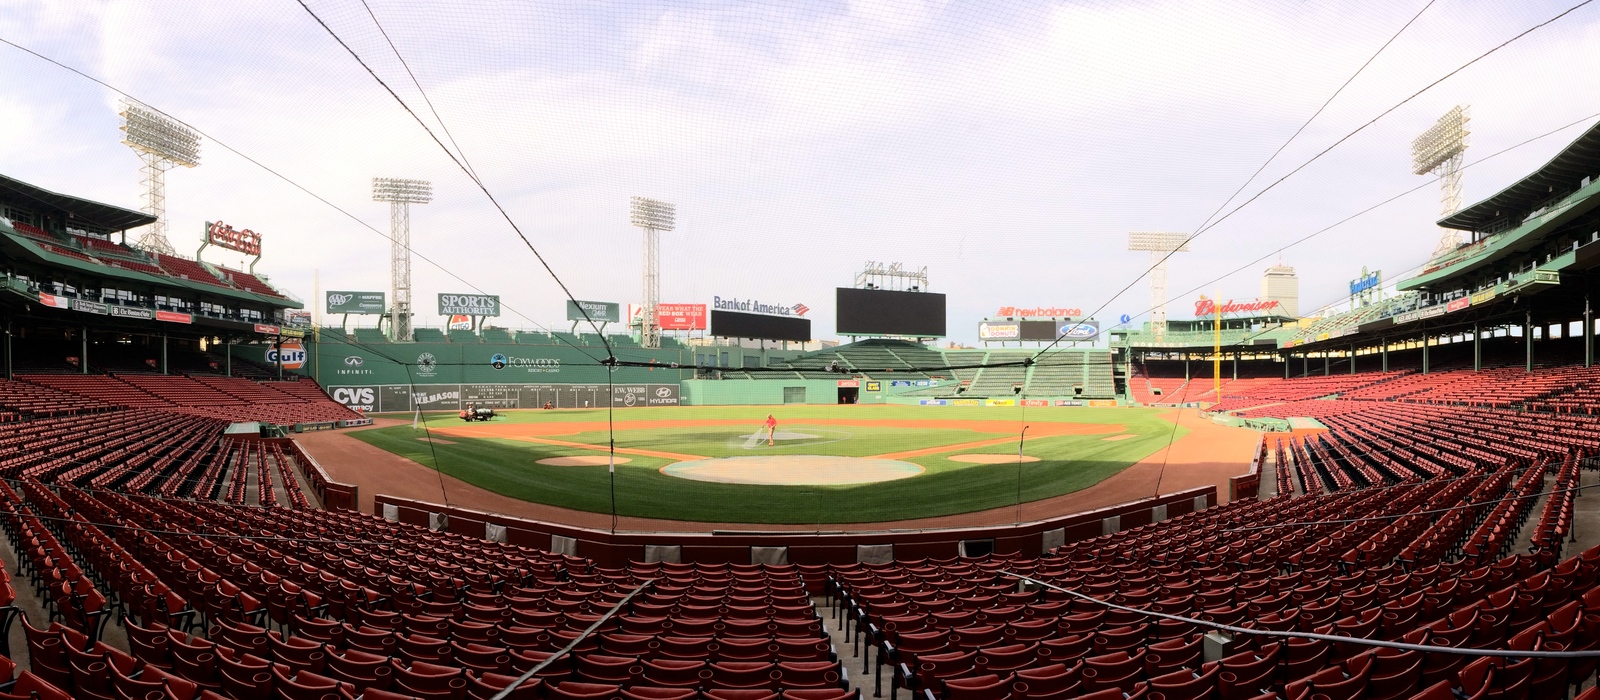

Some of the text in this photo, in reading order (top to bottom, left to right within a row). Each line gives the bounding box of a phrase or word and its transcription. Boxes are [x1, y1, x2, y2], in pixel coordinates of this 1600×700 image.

[441, 294, 495, 308] SPORTS
[579, 301, 607, 311] Nexium
[713, 295, 790, 315] Bank of America
[1037, 306, 1082, 317] balance
[1195, 298, 1279, 317] Budweiser
[451, 322, 469, 330] CITGO
[1068, 327, 1091, 335] Ford
[268, 351, 304, 361] Gulf
[508, 357, 560, 368] FOXWOODS
[333, 387, 375, 405] CVS
